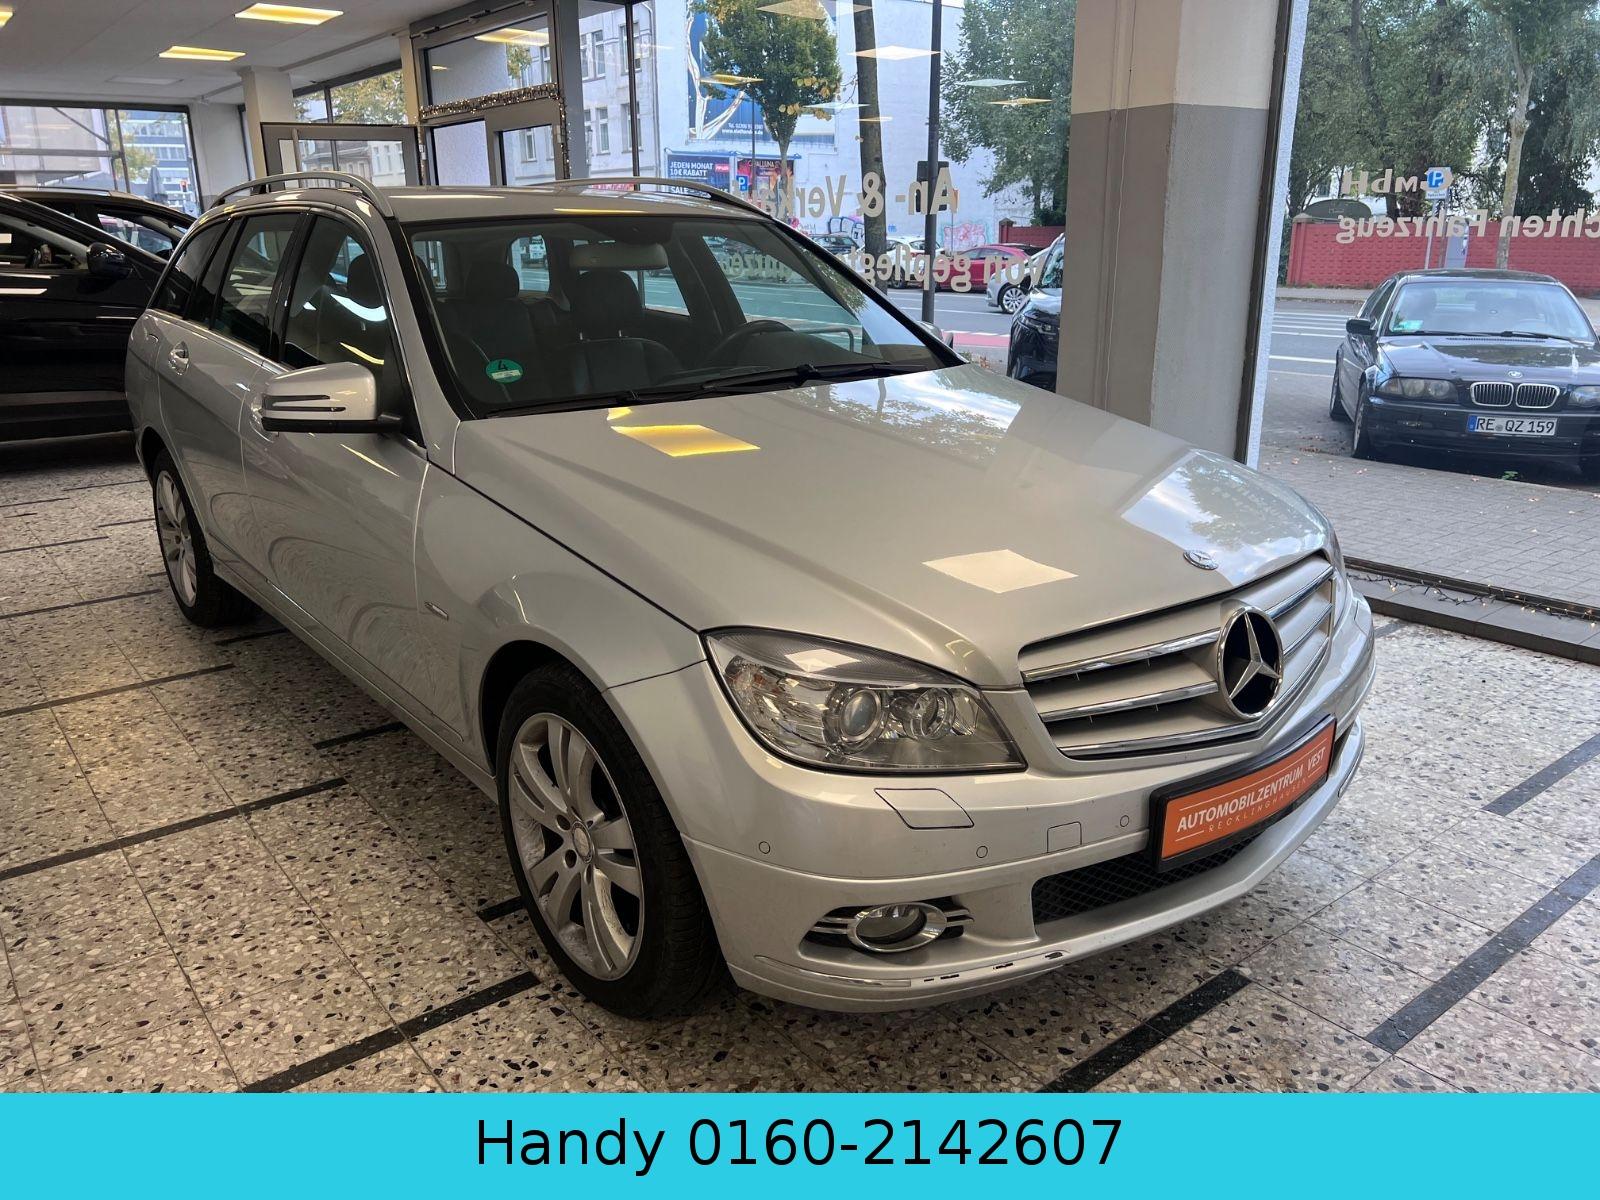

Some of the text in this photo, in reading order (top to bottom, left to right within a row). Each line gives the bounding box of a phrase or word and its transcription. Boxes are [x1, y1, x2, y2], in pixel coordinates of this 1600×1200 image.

[670, 161, 691, 169] JEDEN
[691, 162, 714, 170] MONAT
[683, 169, 707, 177] RABATT
[671, 186, 689, 194] SALE
[1476, 418, 1555, 434] RE QZ 159
[1177, 746, 1327, 833] AUTOMOBILZENTRUM VEST
[1208, 778, 1306, 833] RECKLINGHAUSEN
